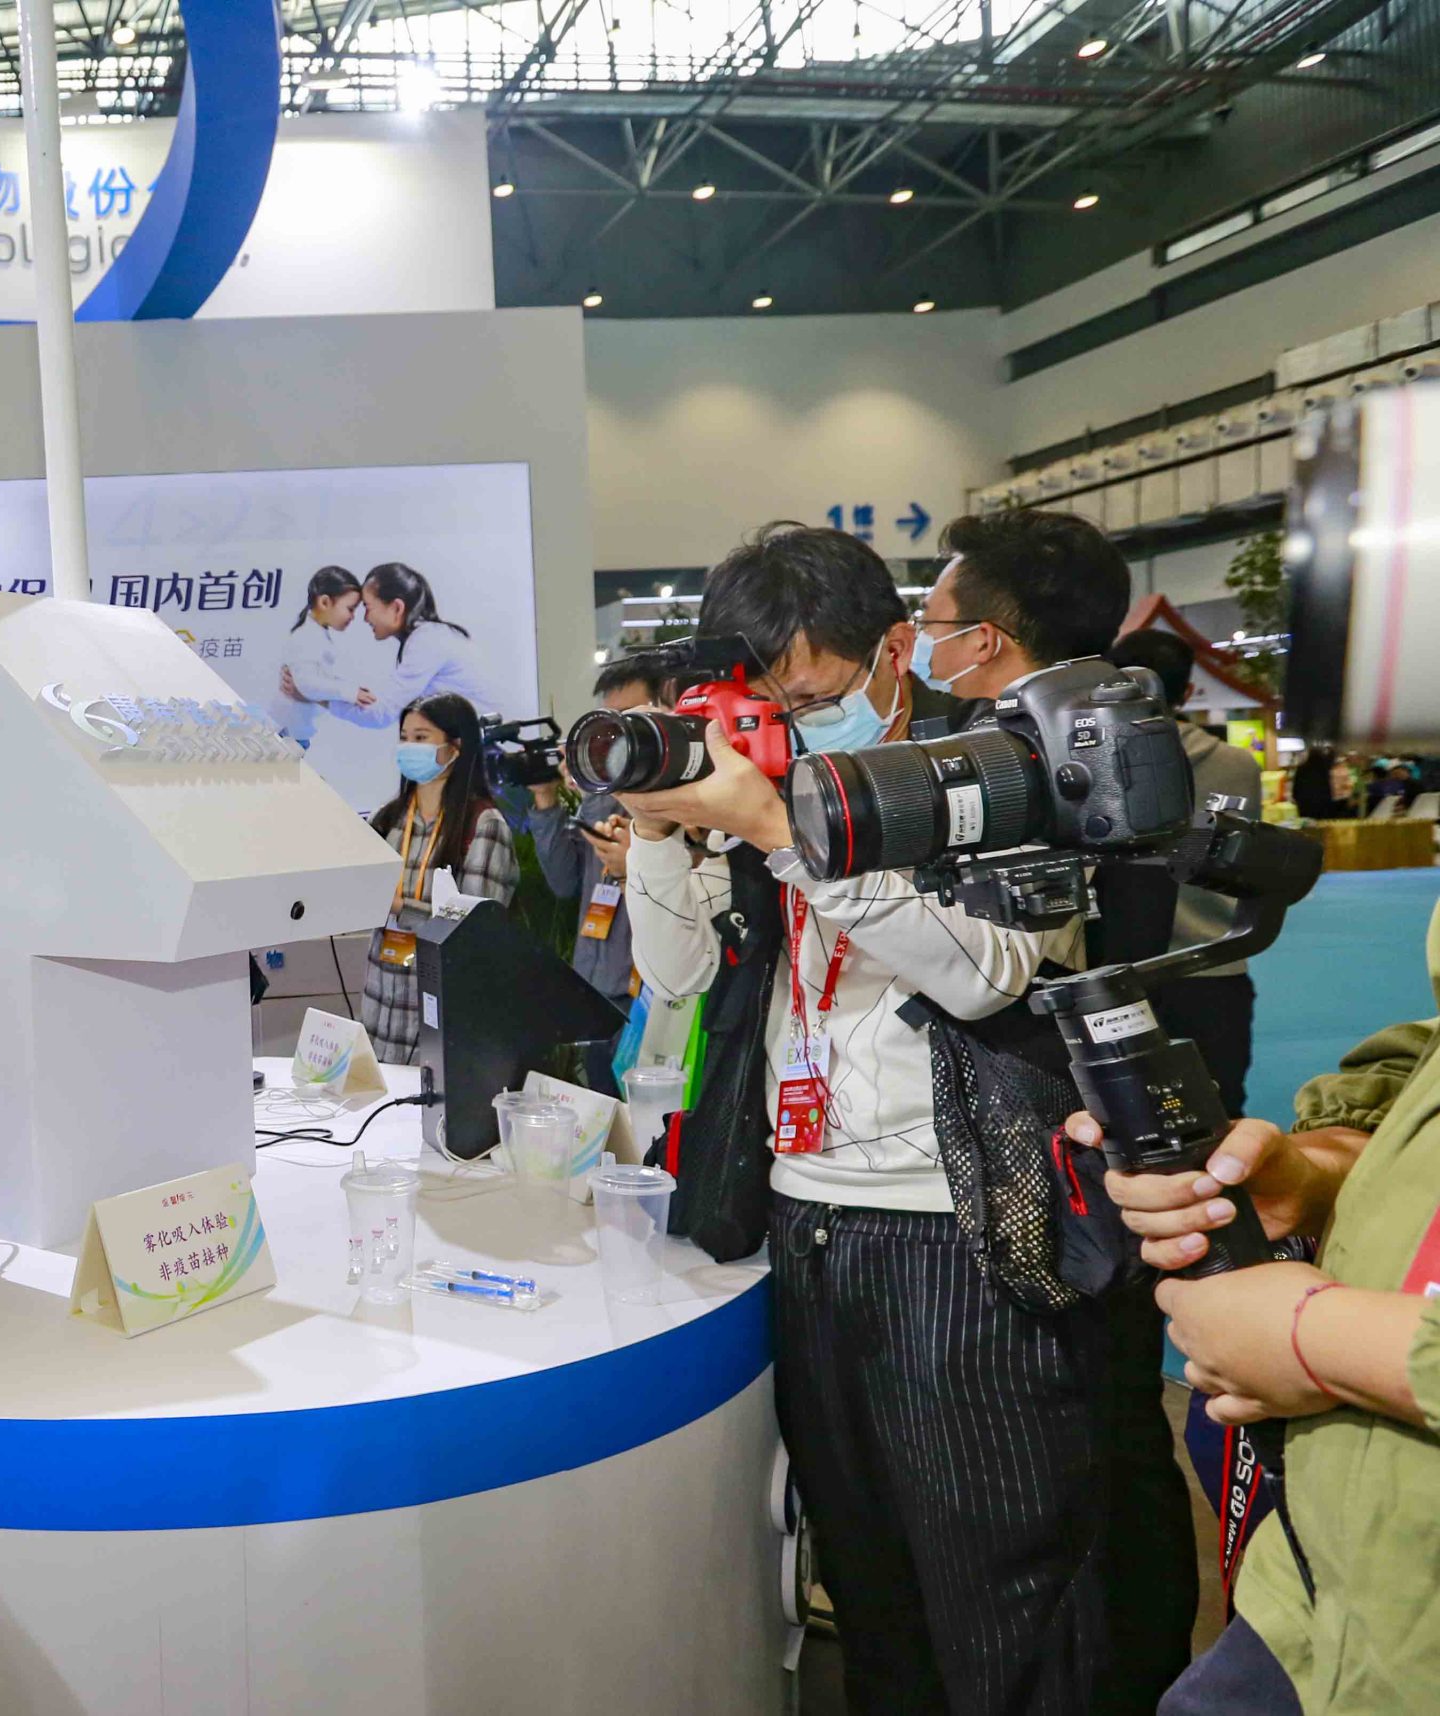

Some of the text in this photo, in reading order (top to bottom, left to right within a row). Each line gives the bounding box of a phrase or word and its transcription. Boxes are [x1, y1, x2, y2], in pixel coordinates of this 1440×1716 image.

[110, 568, 282, 612] 国内首创
[200, 637, 245, 658] 疫苗
[995, 698, 1018, 710] Canon
[1074, 717, 1096, 728] EOS
[1077, 730, 1091, 740] 5D
[143, 1211, 230, 1254] 雾化吸入体验
[160, 1243, 229, 1281] 非疫苗接种
[1230, 1484, 1247, 1518] 6D
[1226, 1518, 1238, 1557] Mark
